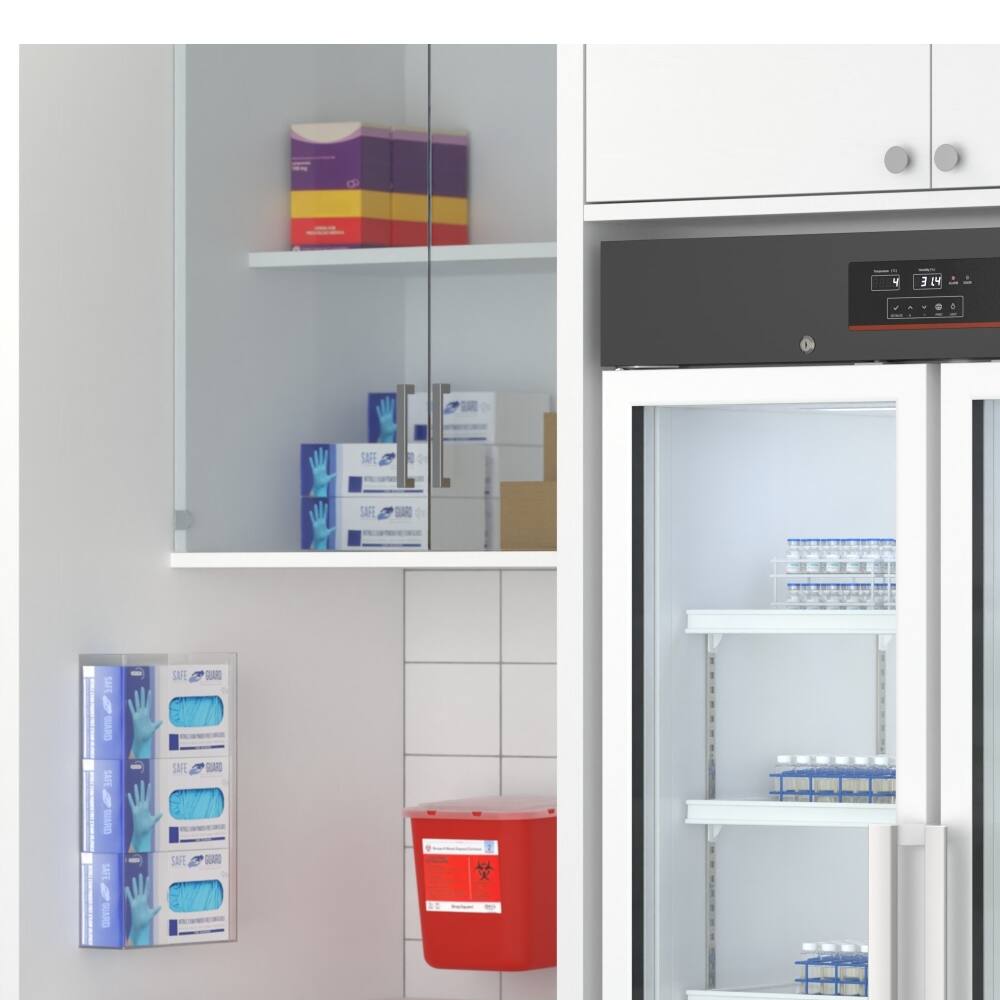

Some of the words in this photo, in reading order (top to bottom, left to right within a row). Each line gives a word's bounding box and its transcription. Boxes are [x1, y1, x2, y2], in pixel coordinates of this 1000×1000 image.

[892, 277, 899, 287] 4
[360, 452, 376, 465] SAFE
[360, 505, 376, 518] SAFE
[394, 505, 413, 518] GUARD
[172, 670, 187, 681] SAFE
[205, 669, 222, 681] GUARD
[172, 763, 187, 775] SAFE
[205, 762, 223, 773] GUARD
[171, 855, 187, 866] SAFE
[204, 853, 222, 865] GUARD
